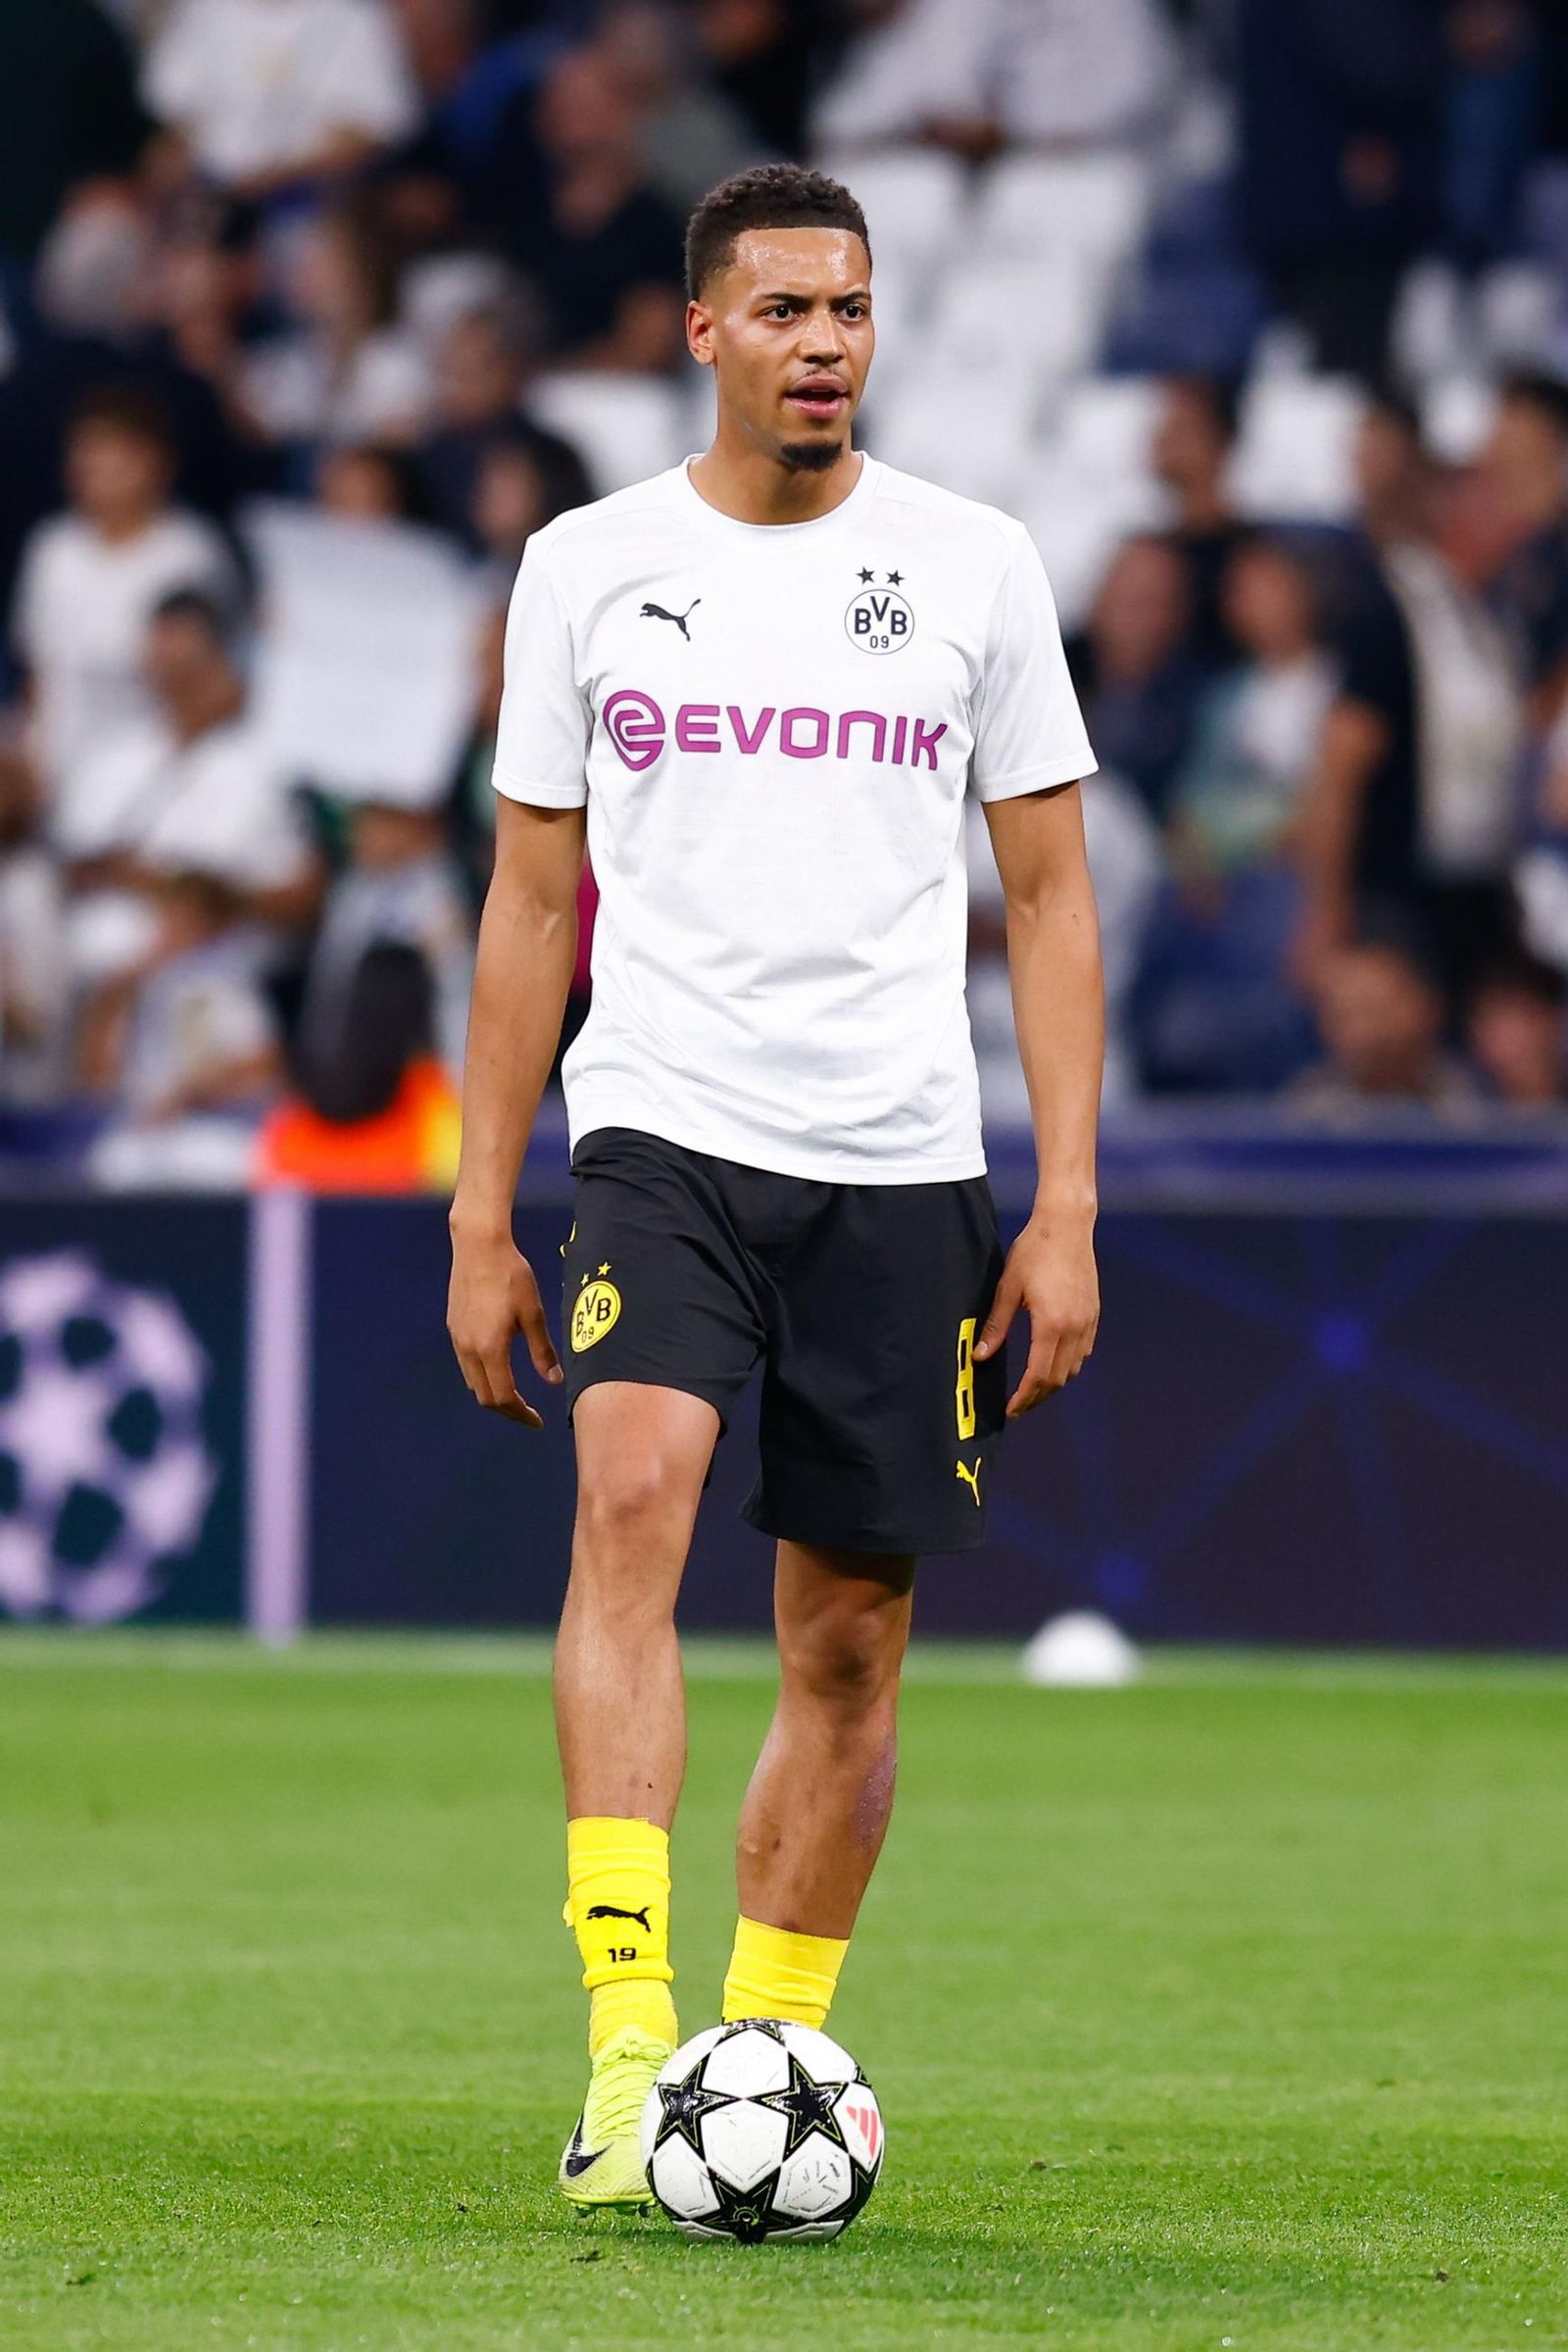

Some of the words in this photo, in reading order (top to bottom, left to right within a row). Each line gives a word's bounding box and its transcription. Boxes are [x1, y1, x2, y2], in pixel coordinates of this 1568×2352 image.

[855, 596, 907, 635] BVB
[869, 635, 889, 649] 09
[675, 704, 948, 770] EVONIK
[576, 1289, 612, 1337] BVB
[581, 1326, 595, 1344] 09
[608, 1947, 637, 1963] 19
